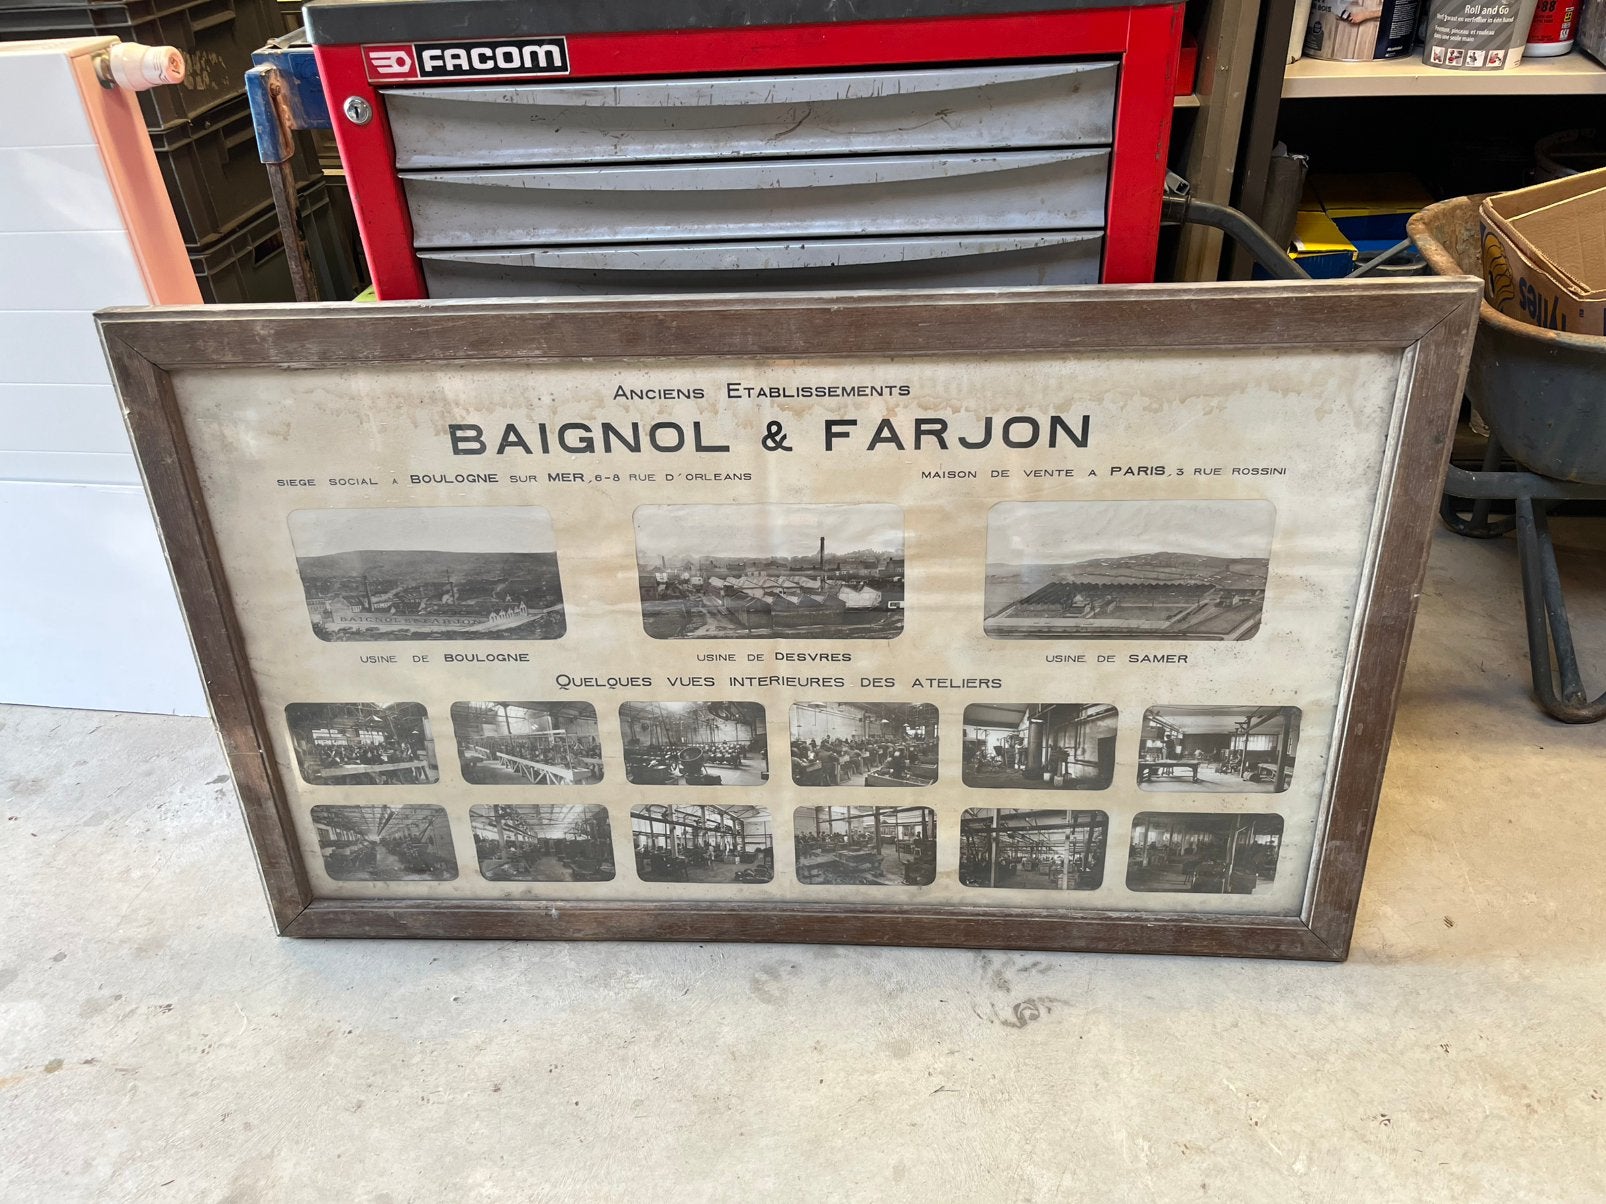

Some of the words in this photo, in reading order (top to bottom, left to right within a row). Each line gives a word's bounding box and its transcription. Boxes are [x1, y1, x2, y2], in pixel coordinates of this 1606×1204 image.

[1465, 5, 1480, 14] Roll
[1482, 5, 1498, 14] and
[1499, 5, 1509, 14] Go
[422, 45, 562, 72] FACOM
[612, 384, 705, 401] ANCIENS
[726, 382, 911, 399] ETABLISSEMENTS
[447, 420, 731, 456] BAIGNOL
[760, 419, 794, 453] &
[824, 414, 1091, 452] FARJON
[276, 478, 317, 487] SIEGE
[328, 477, 379, 486] SOCIAL
[391, 477, 399, 485] A
[409, 473, 500, 485] BOULOGNE
[509, 474, 538, 484] SUR
[628, 473, 657, 482] RUE
[921, 470, 977, 480] MAISON
[990, 469, 1011, 478] DE
[1023, 468, 1075, 478] VENTE
[1087, 469, 1098, 477] A
[1193, 467, 1223, 476] RUE
[1231, 467, 1287, 476] ROSSINI
[359, 655, 398, 664] USINE
[412, 654, 430, 663] DE
[443, 653, 531, 663] BOULOGNE
[696, 653, 737, 662] USINE
[746, 653, 765, 662] DE
[774, 651, 852, 662] DESVRES
[1045, 654, 1087, 663] USINE
[1096, 654, 1116, 663] DE
[1128, 654, 1189, 664] SAMER
[555, 673, 653, 691] QUELQUES
[666, 676, 716, 687] VUES
[729, 675, 845, 688] INTERIEURES
[860, 677, 896, 688] DES
[911, 677, 1002, 689] ATELIERS
